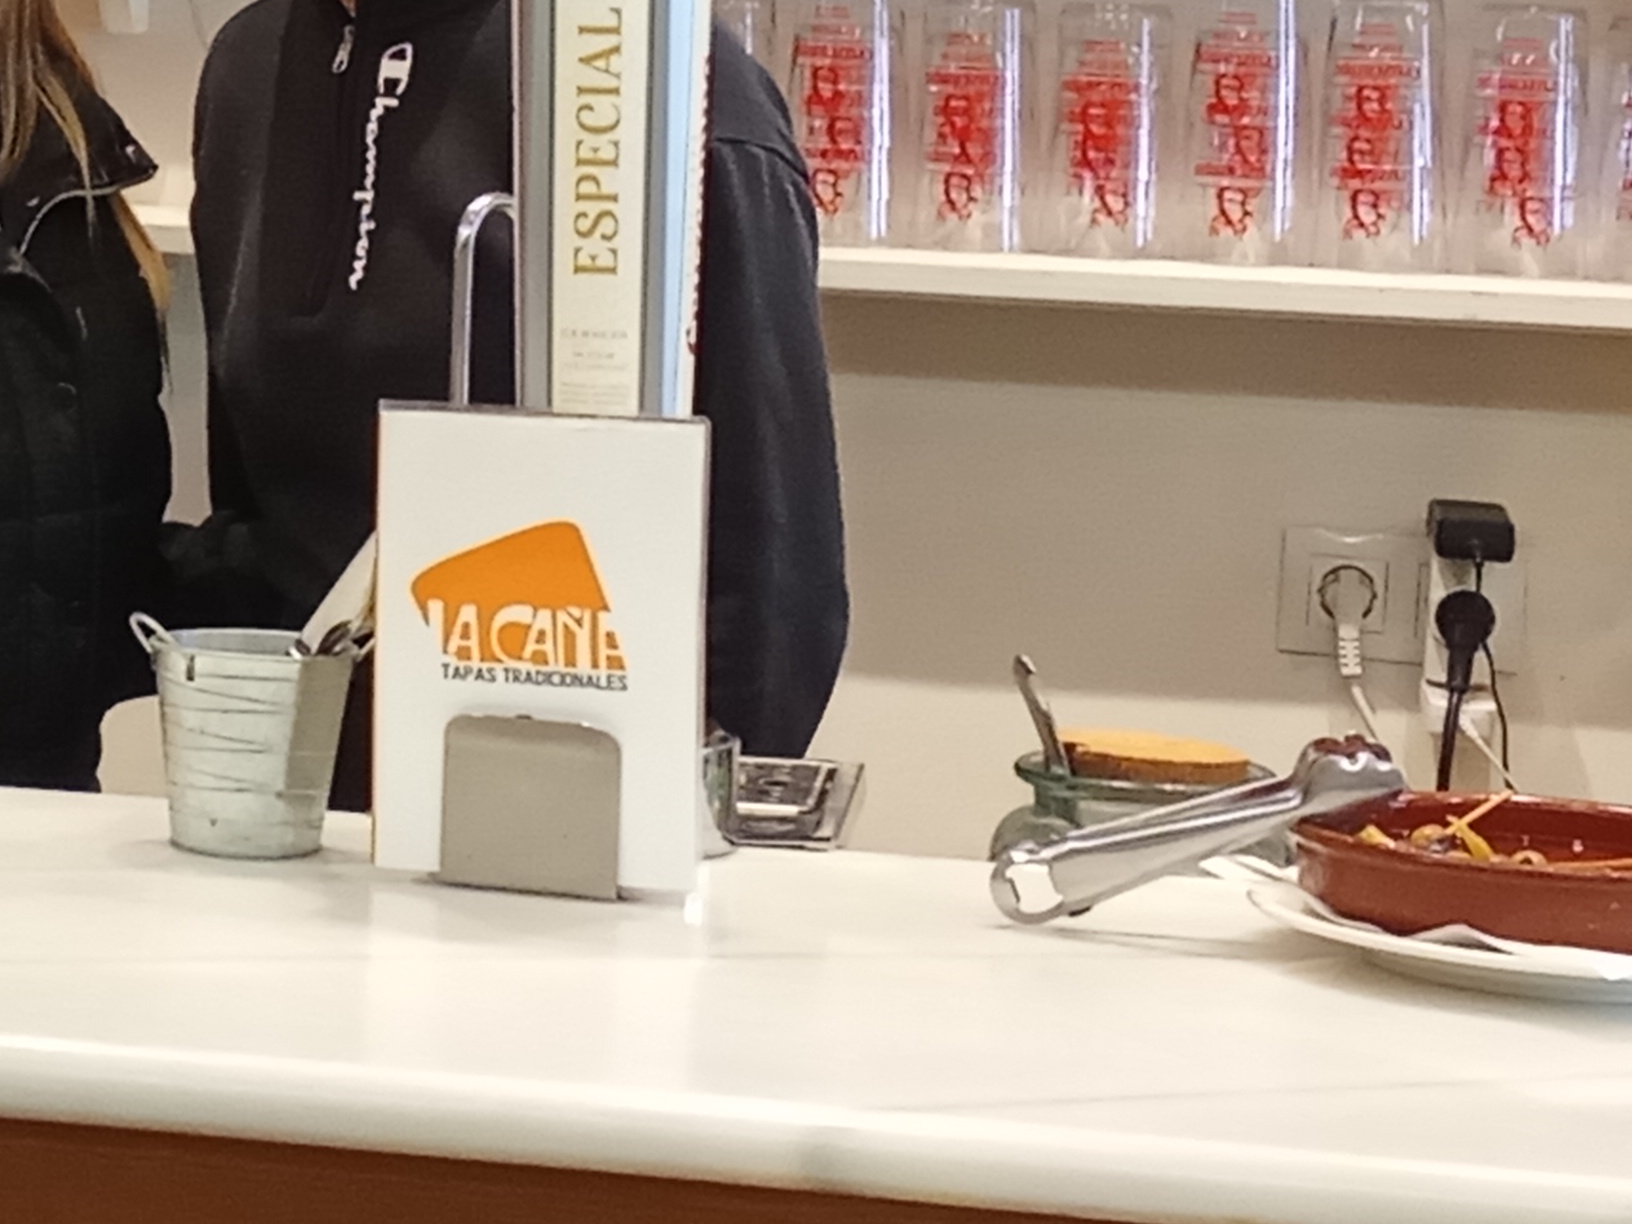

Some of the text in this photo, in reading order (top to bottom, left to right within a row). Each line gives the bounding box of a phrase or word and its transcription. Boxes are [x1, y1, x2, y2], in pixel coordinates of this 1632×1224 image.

[348, 41, 414, 291] Champion
[572, 6, 624, 277] ESPECIAL
[441, 663, 628, 692] TAPAS TRADICIONALES
[489, 602, 630, 671] CAÑA
